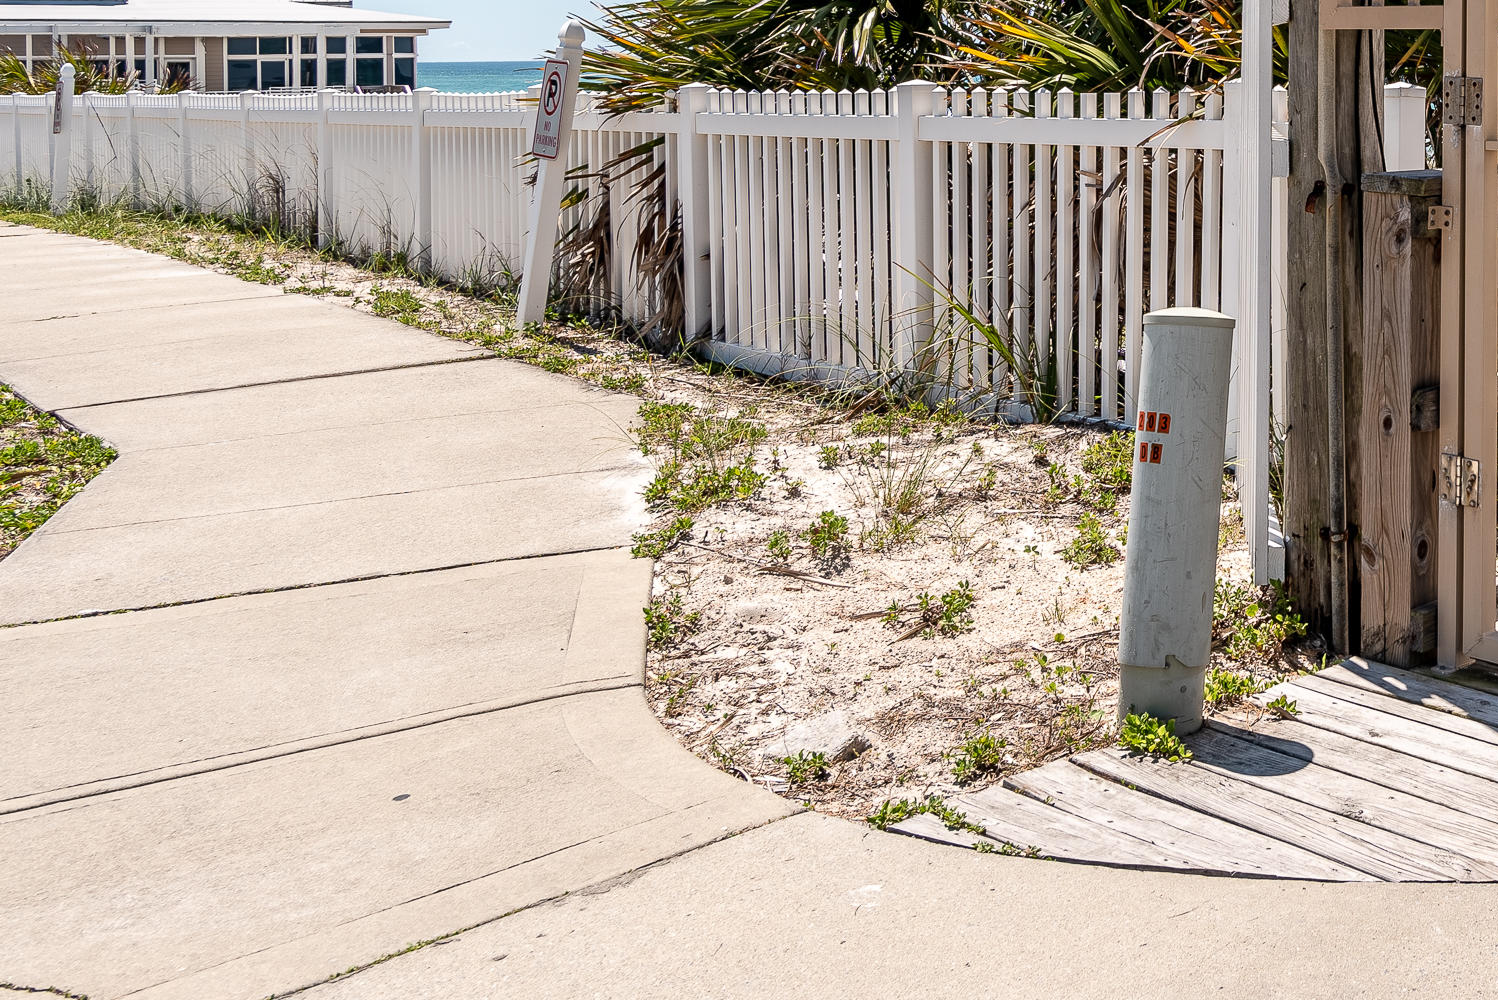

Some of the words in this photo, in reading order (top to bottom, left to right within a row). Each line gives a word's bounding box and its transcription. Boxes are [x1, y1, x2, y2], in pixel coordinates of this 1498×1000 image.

[543, 120, 552, 132] NO
[535, 133, 557, 148] PARKING
[1138, 414, 1168, 430] 203
